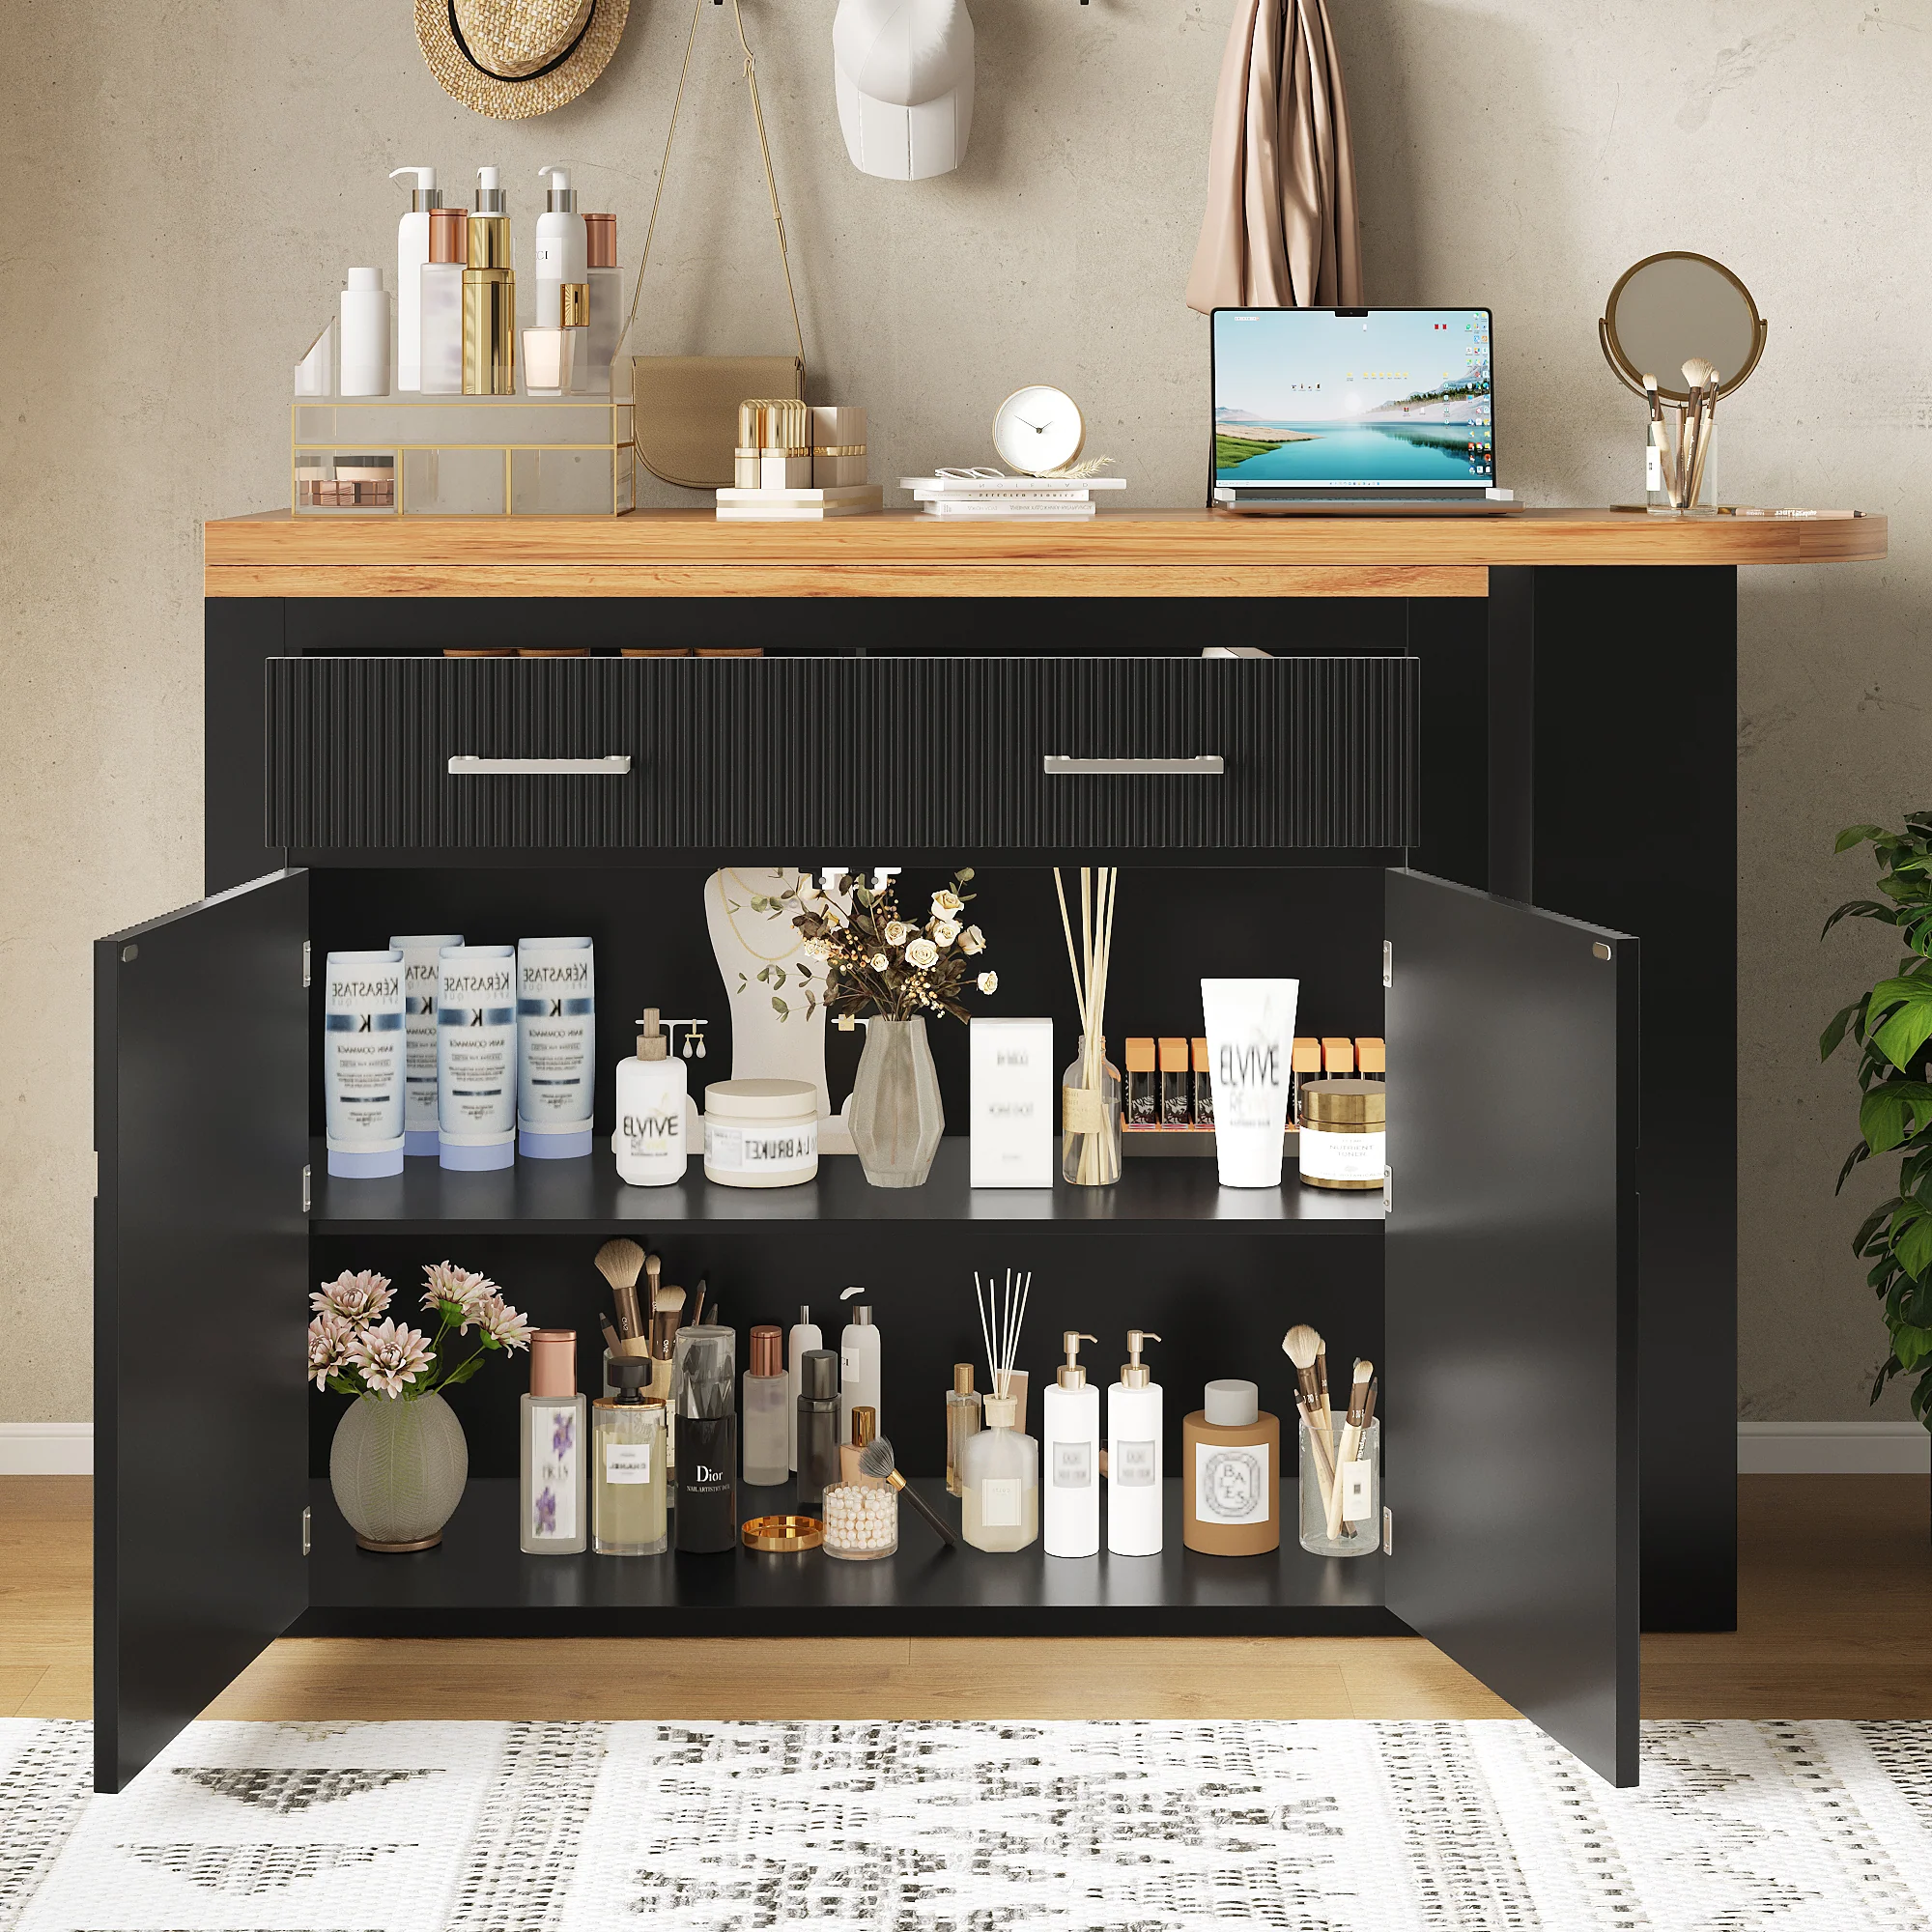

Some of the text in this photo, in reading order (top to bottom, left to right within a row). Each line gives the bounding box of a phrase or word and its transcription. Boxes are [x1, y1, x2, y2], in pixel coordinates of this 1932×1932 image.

[1220, 1042, 1279, 1088] ELVIVE
[623, 1115, 678, 1138] ELVIVE
[696, 1464, 724, 1483] Dior
